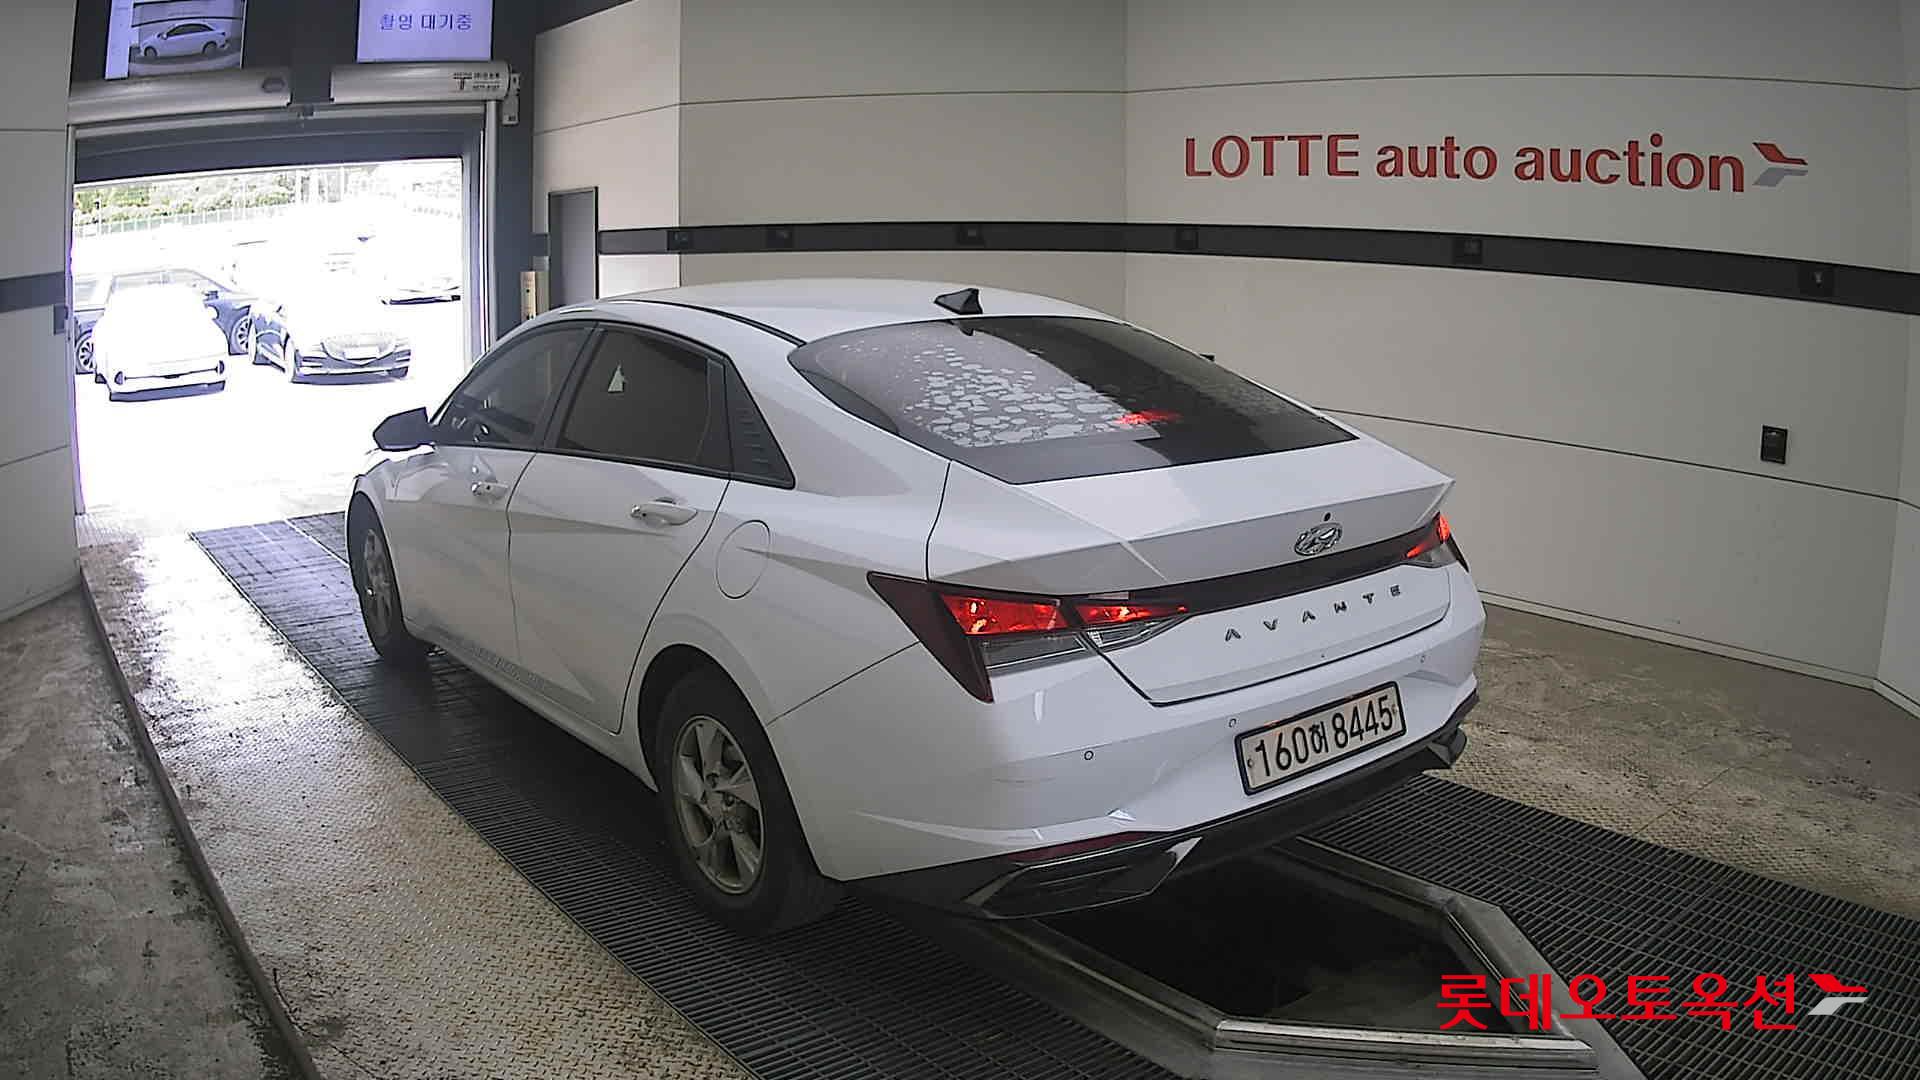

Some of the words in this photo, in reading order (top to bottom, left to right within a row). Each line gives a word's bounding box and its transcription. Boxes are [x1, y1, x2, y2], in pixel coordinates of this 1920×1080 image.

[421, 13, 472, 31] 대기중
[1185, 134, 1360, 178] LOTTE
[1376, 135, 1498, 180] auto
[1514, 133, 1745, 193] auction
[1225, 584, 1401, 642] AVANTE
[1254, 695, 1394, 778] 160허8445
